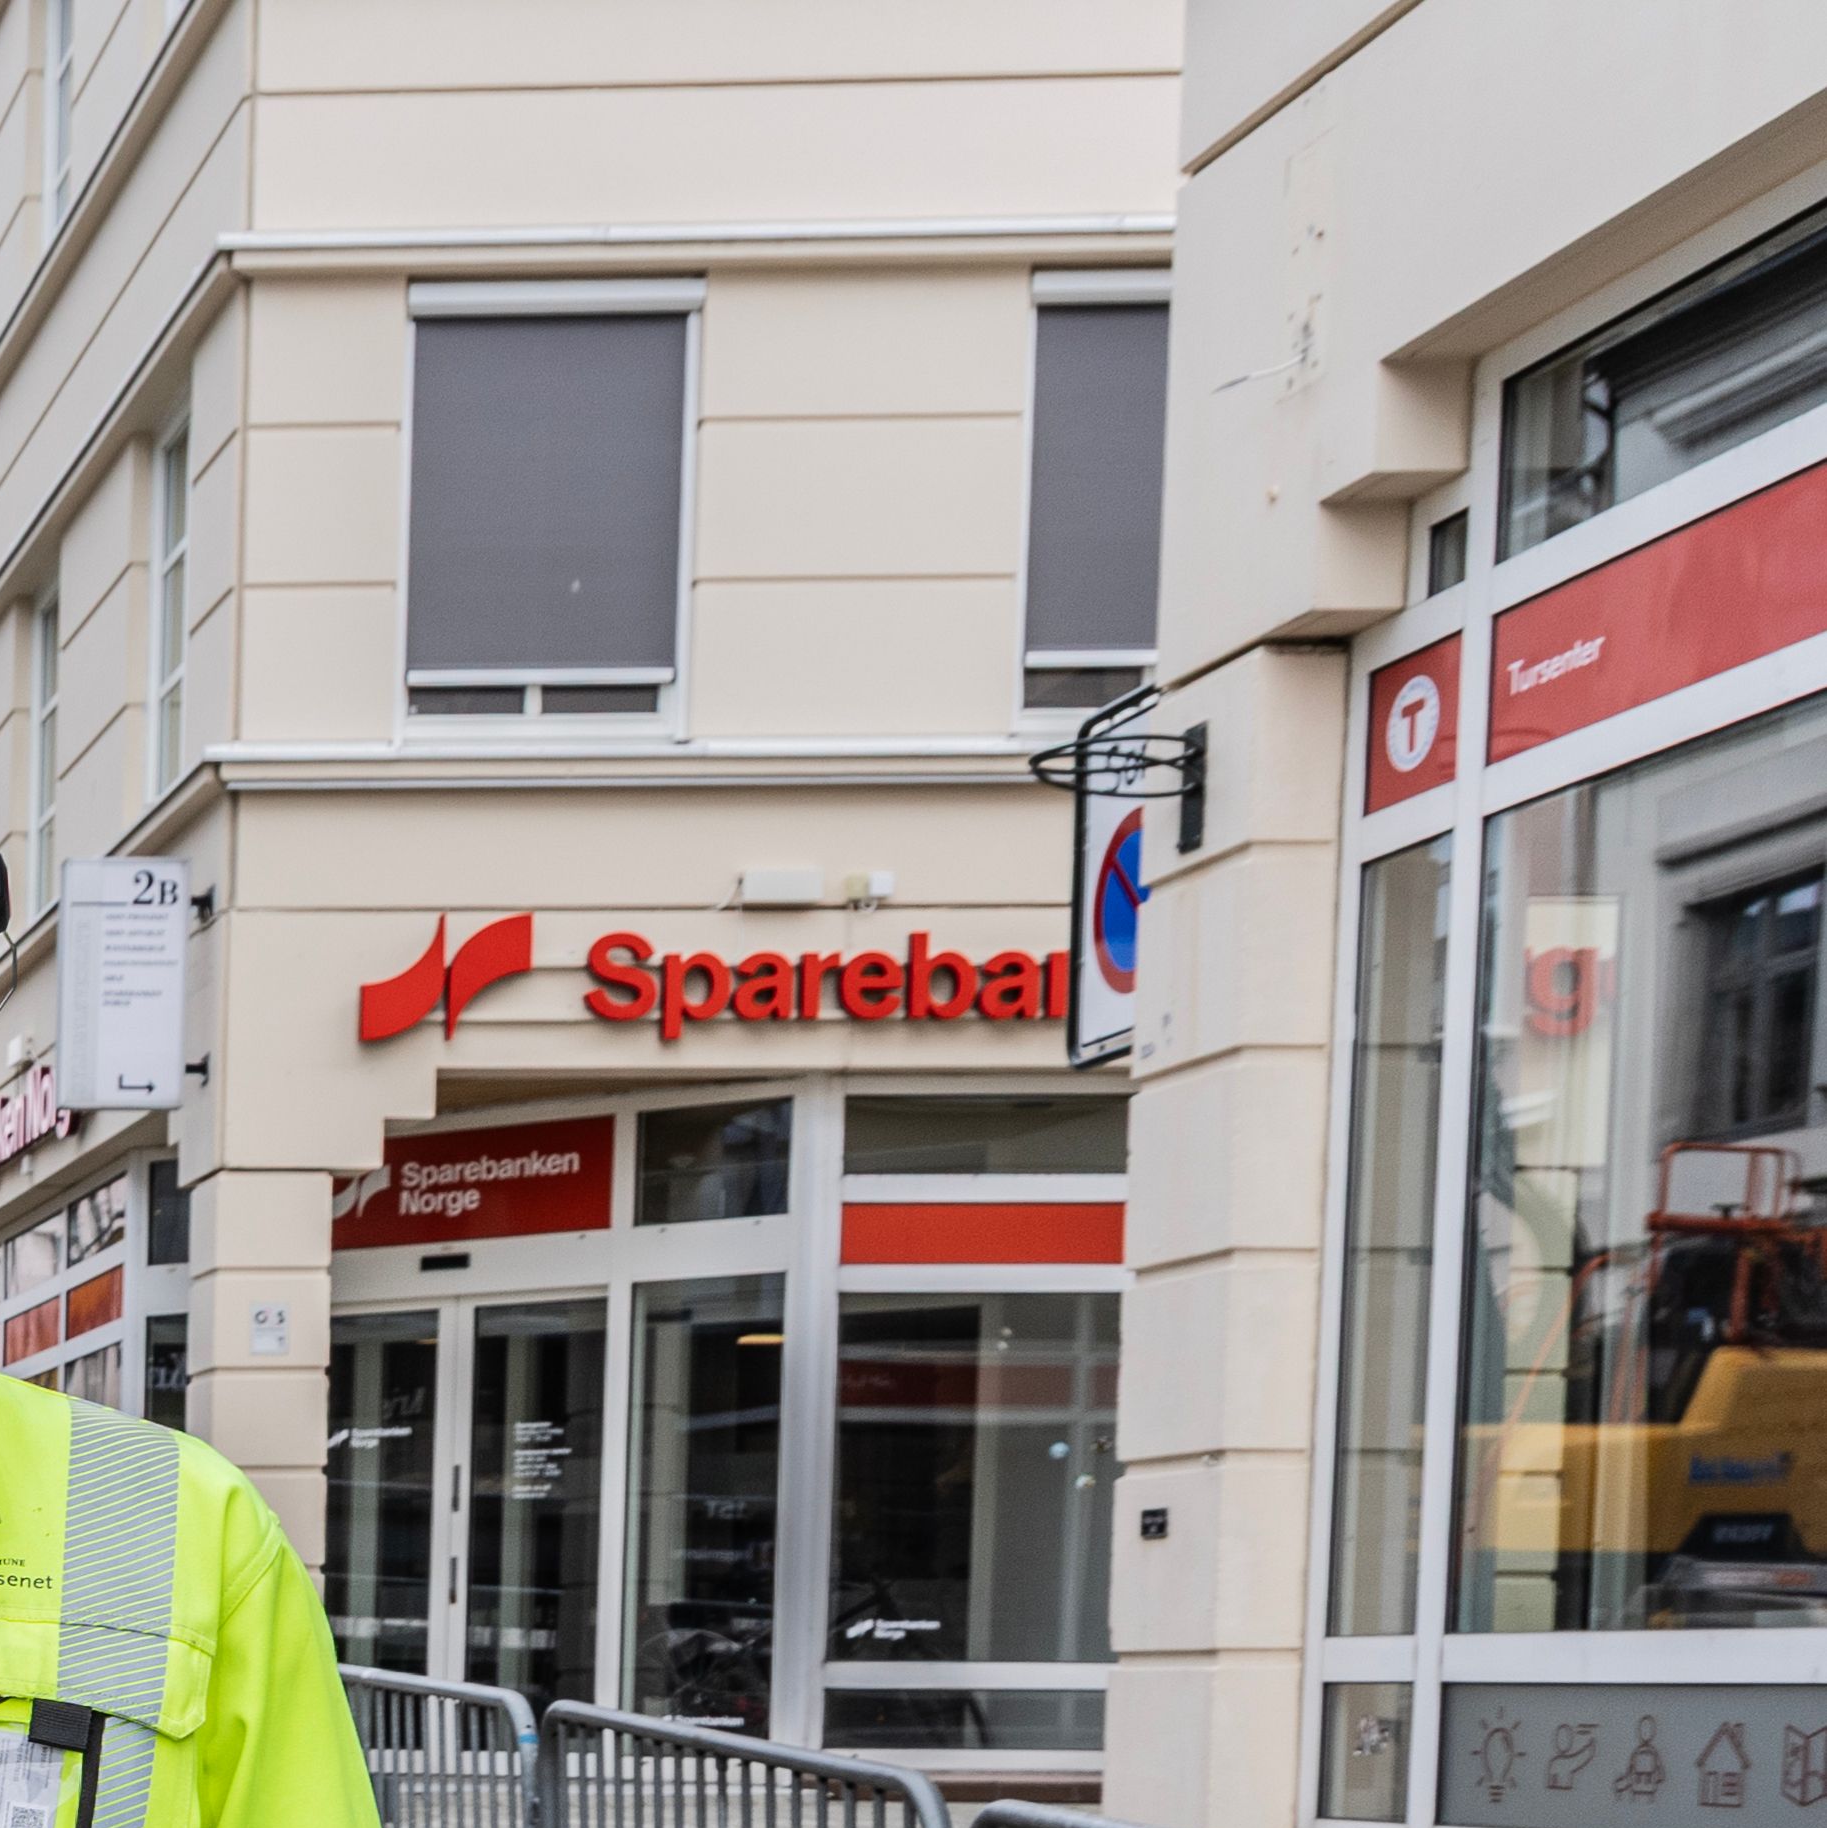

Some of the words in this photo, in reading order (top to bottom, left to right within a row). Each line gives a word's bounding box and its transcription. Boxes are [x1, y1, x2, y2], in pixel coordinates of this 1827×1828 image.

[1506, 635, 1607, 697] Tursenter
[400, 1150, 581, 1190] Sparebanken
[398, 1187, 481, 1218] Norge
